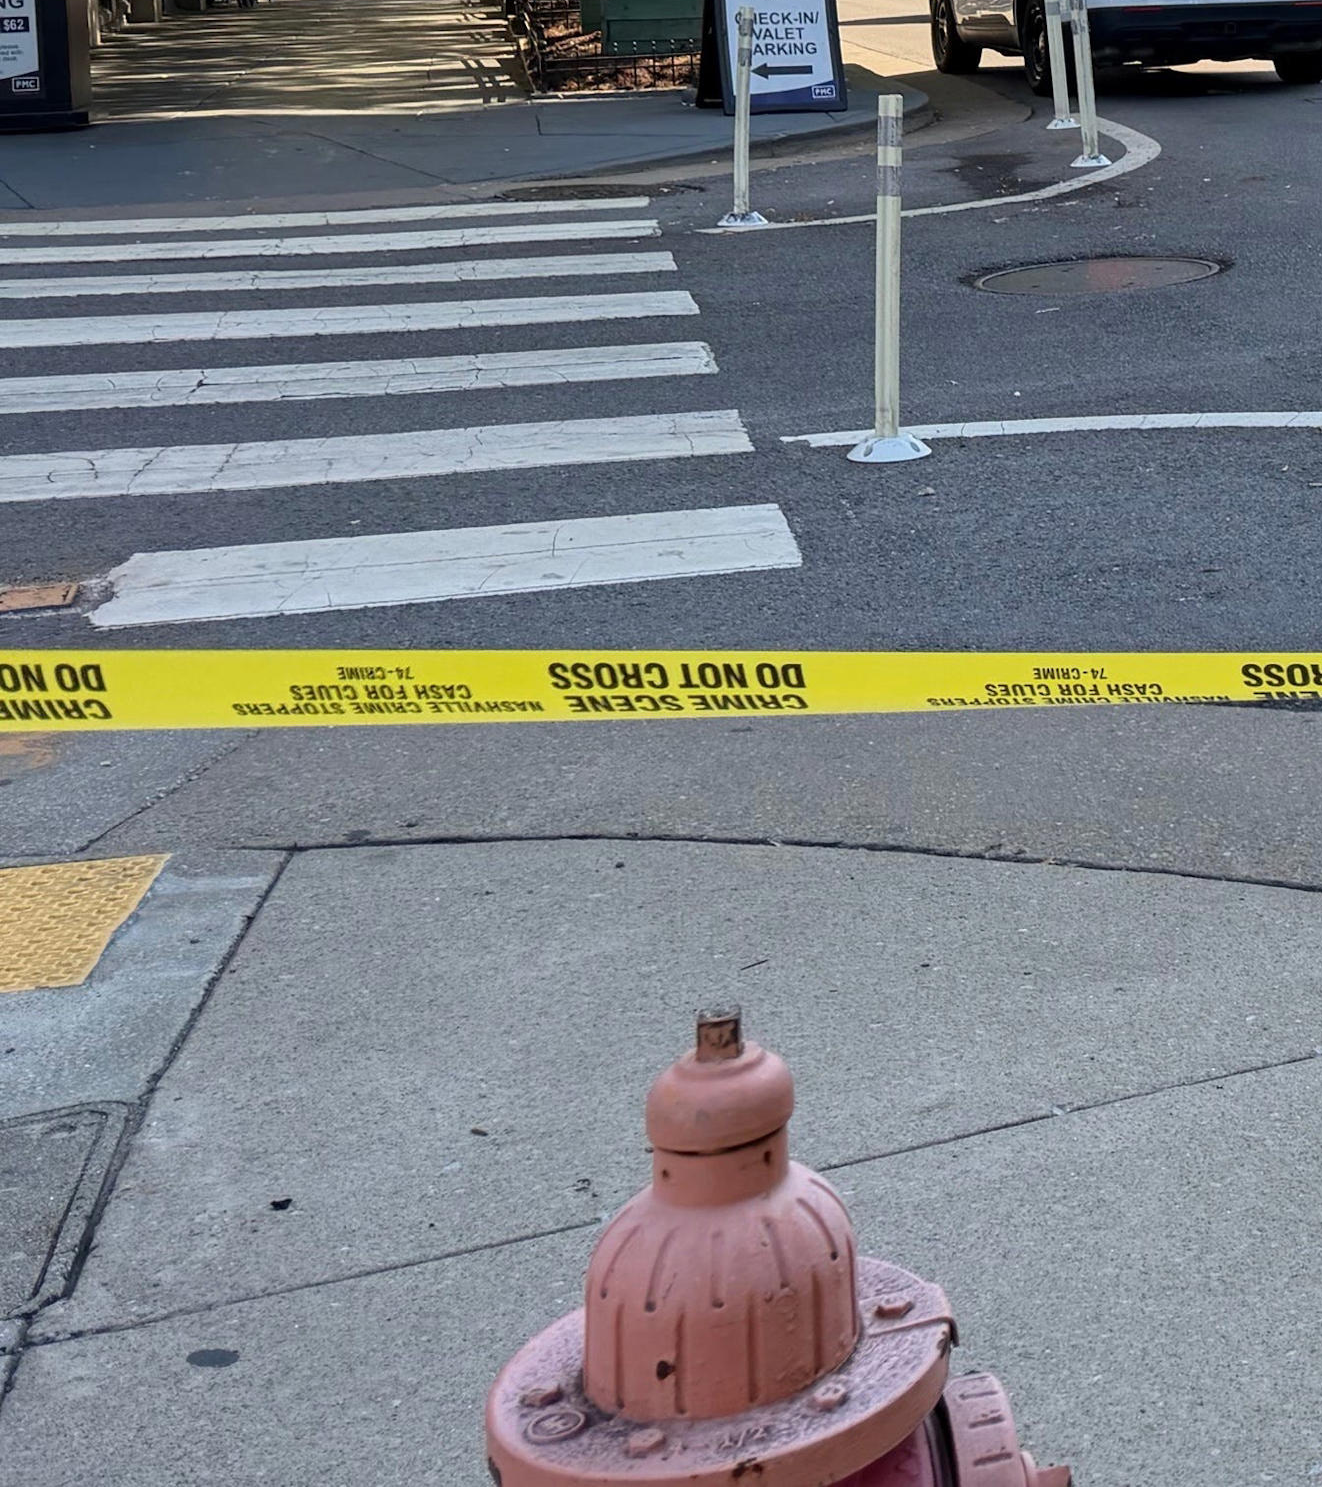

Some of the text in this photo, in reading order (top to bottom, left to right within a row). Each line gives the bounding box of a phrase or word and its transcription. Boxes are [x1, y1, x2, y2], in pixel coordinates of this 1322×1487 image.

[3, 19, 24, 31] $62
[752, 27, 804, 40] VALET
[753, 42, 817, 55] ARKING
[16, 80, 36, 89] PMC
[0, 664, 107, 692] DO NO
[336, 666, 415, 680] 74-CRIME
[547, 662, 807, 690] DO NOT CROSS
[1032, 667, 1108, 679] 74-CRIME
[289, 683, 472, 701] CASH FOR CLUES
[984, 683, 1163, 697] CASH FOR CLUES
[232, 700, 545, 716] NASHVILLE CRIME STOPPERS
[564, 694, 809, 713] CRIME SCENE
